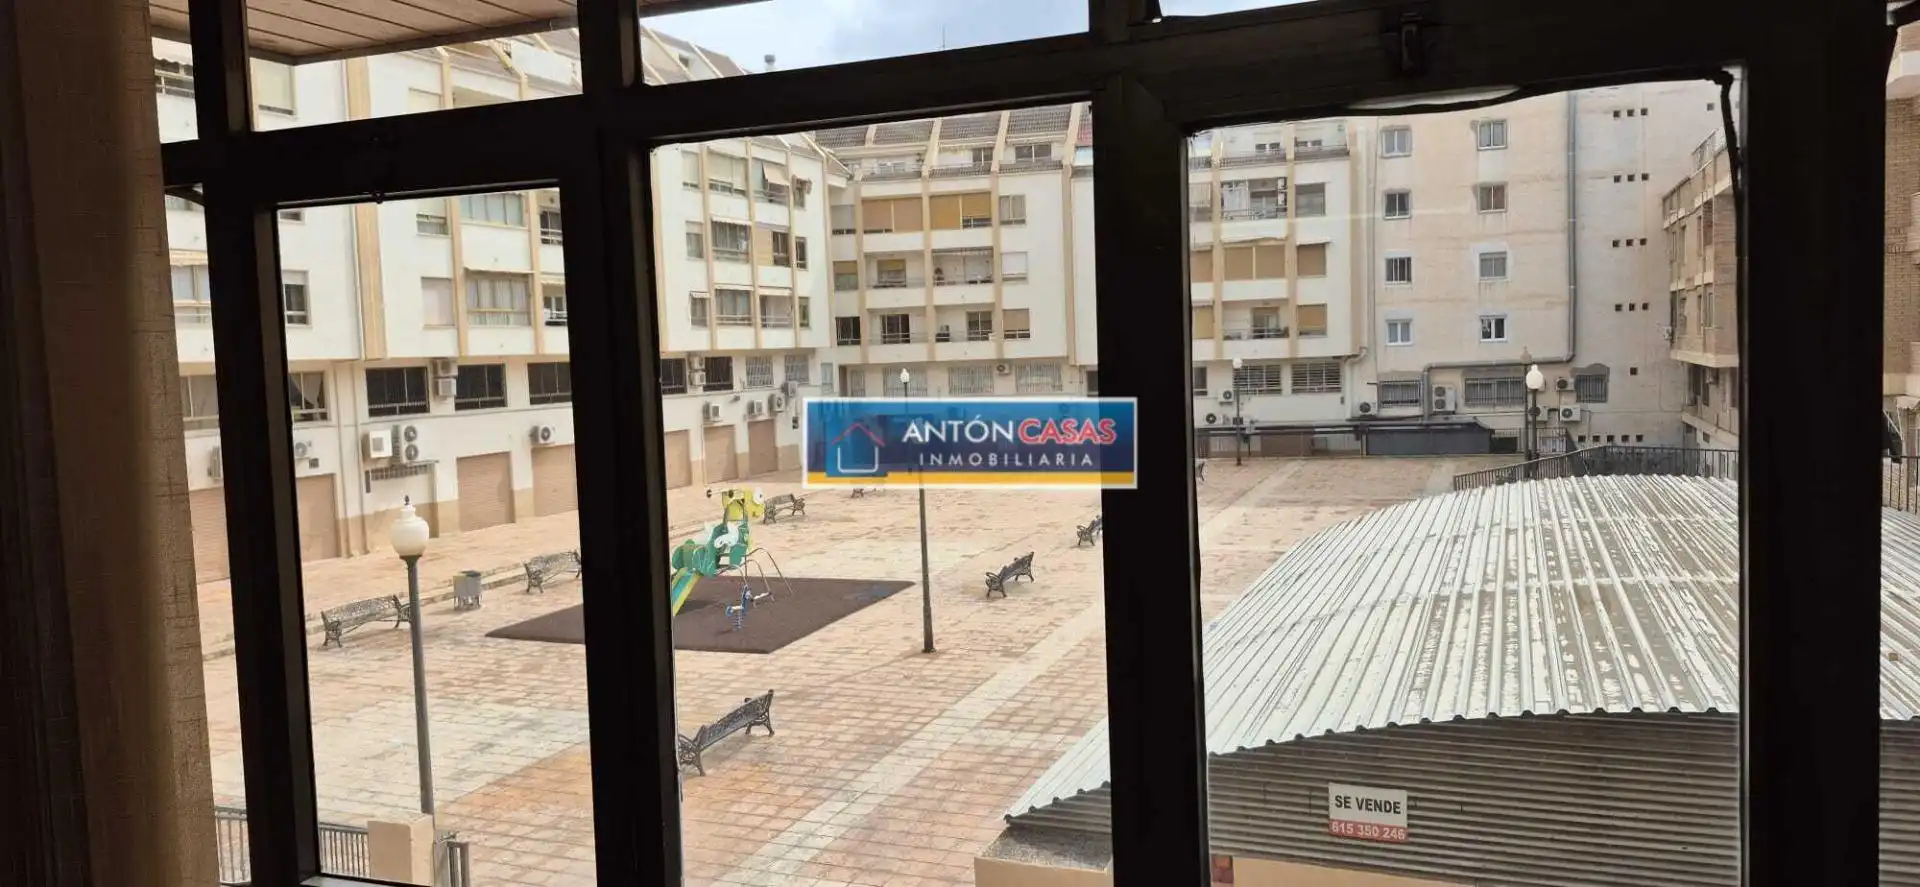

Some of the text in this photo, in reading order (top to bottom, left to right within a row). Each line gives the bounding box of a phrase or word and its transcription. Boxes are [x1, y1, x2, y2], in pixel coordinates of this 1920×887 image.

[1334, 795, 1402, 815] SE VENDE
[1331, 821, 1405, 840] 615 350 246
